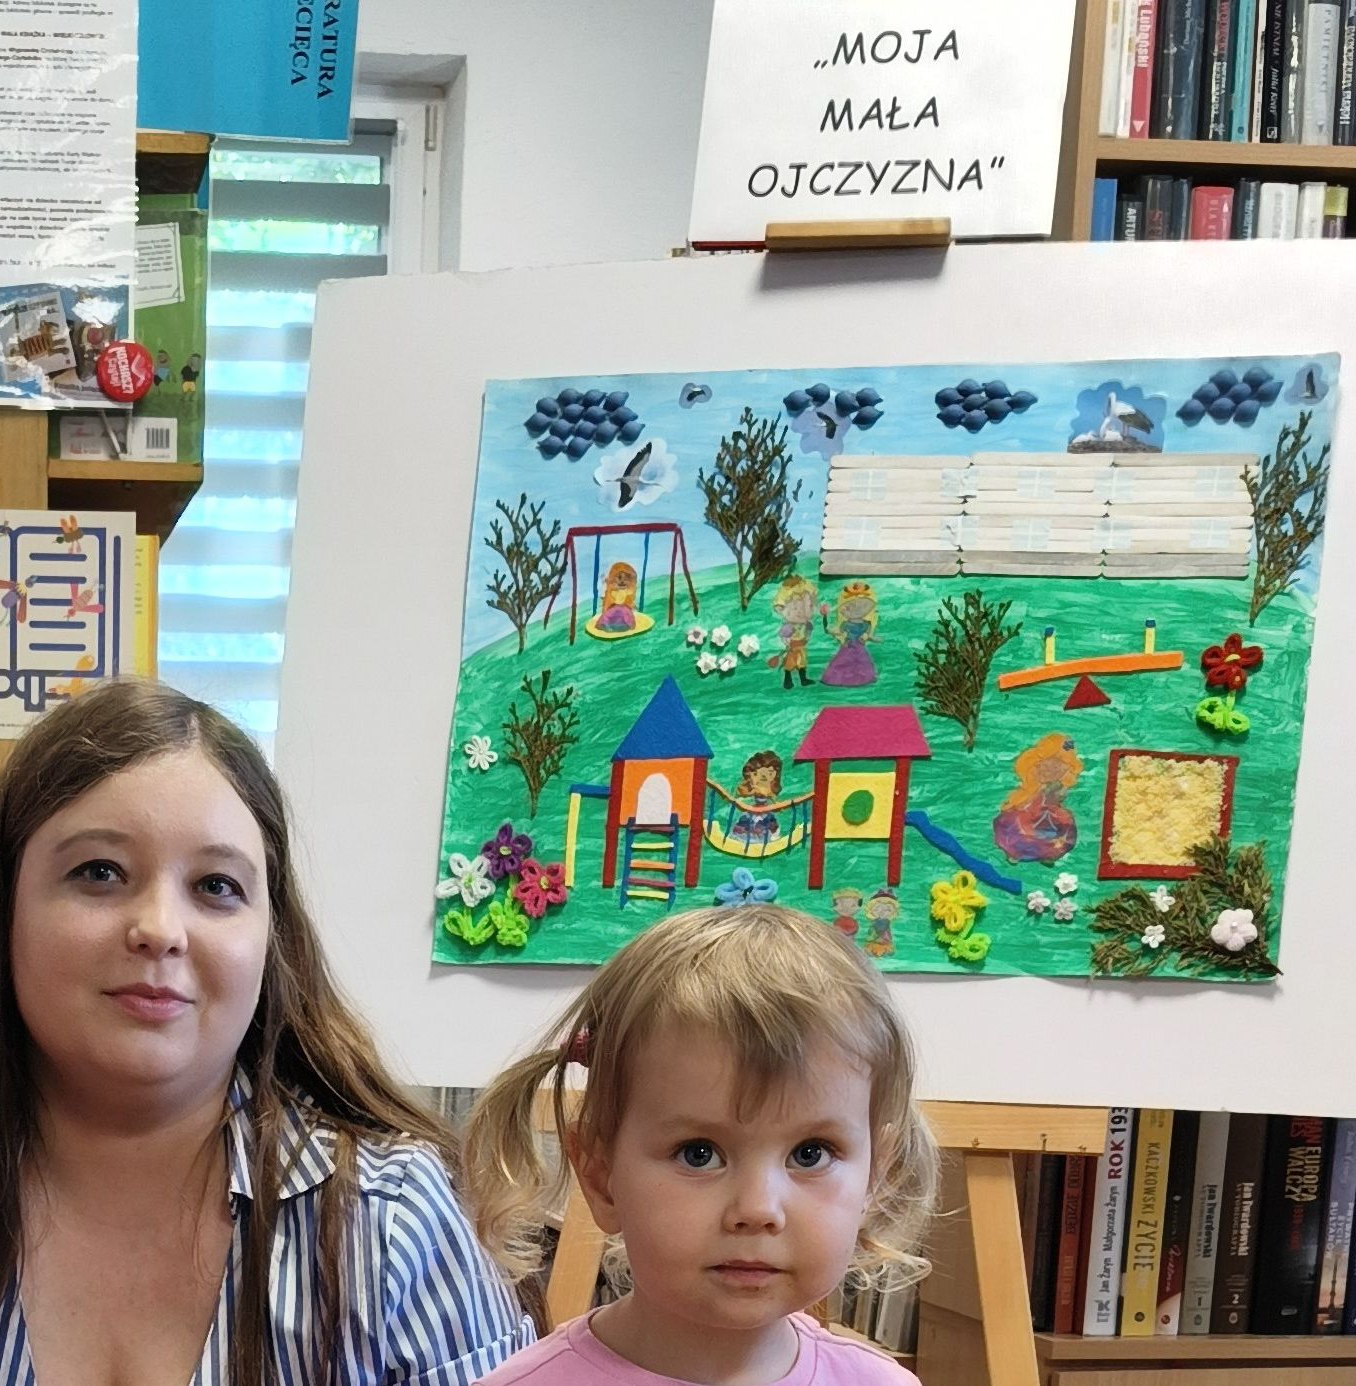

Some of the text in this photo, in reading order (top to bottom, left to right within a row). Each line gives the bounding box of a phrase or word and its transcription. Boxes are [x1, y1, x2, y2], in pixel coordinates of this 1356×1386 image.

[819, 96, 940, 132] MAŁA
[1107, 1139, 1125, 1180] ROK
[1141, 1142, 1161, 1215] KACZKOWSKI
[1284, 1146, 1307, 1202] WALCZY
[1301, 1146, 1322, 1203] EUROPA
[1102, 1208, 1117, 1252] Małgorzata
[1238, 1200, 1253, 1256] Twardowski
[1098, 1280, 1111, 1293] Jan
